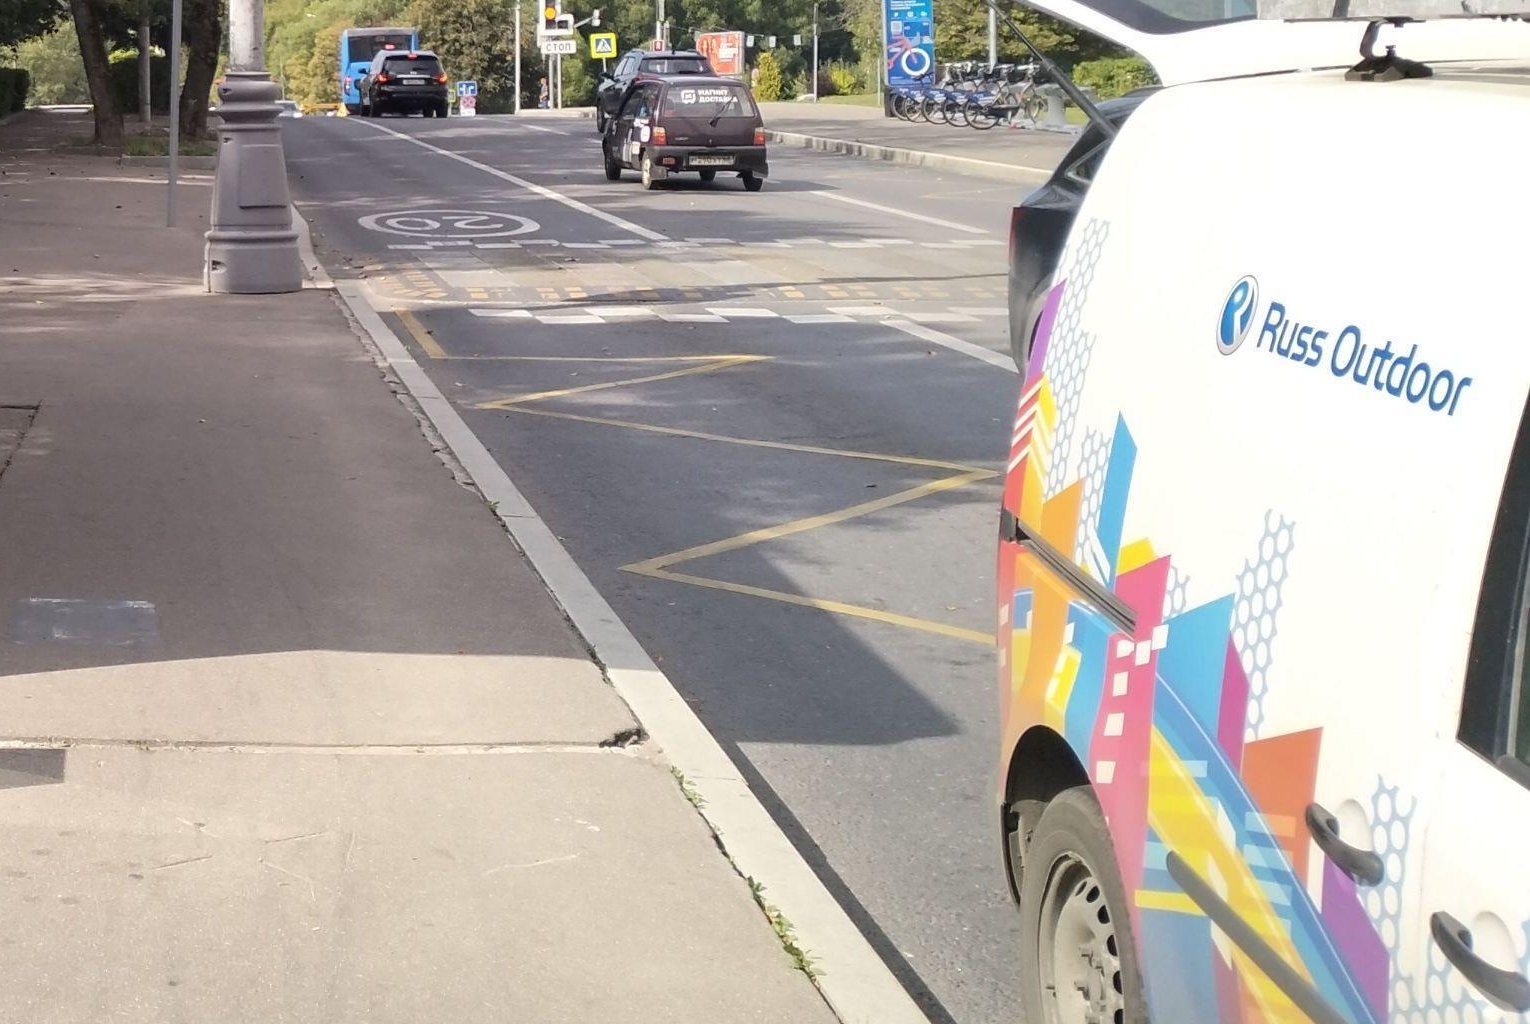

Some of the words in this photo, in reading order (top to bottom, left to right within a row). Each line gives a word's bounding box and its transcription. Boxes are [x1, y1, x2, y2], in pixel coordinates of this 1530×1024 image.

[546, 43, 571, 52] СТОП
[1256, 301, 1329, 368] Russ
[1330, 325, 1473, 416] Outdoor
